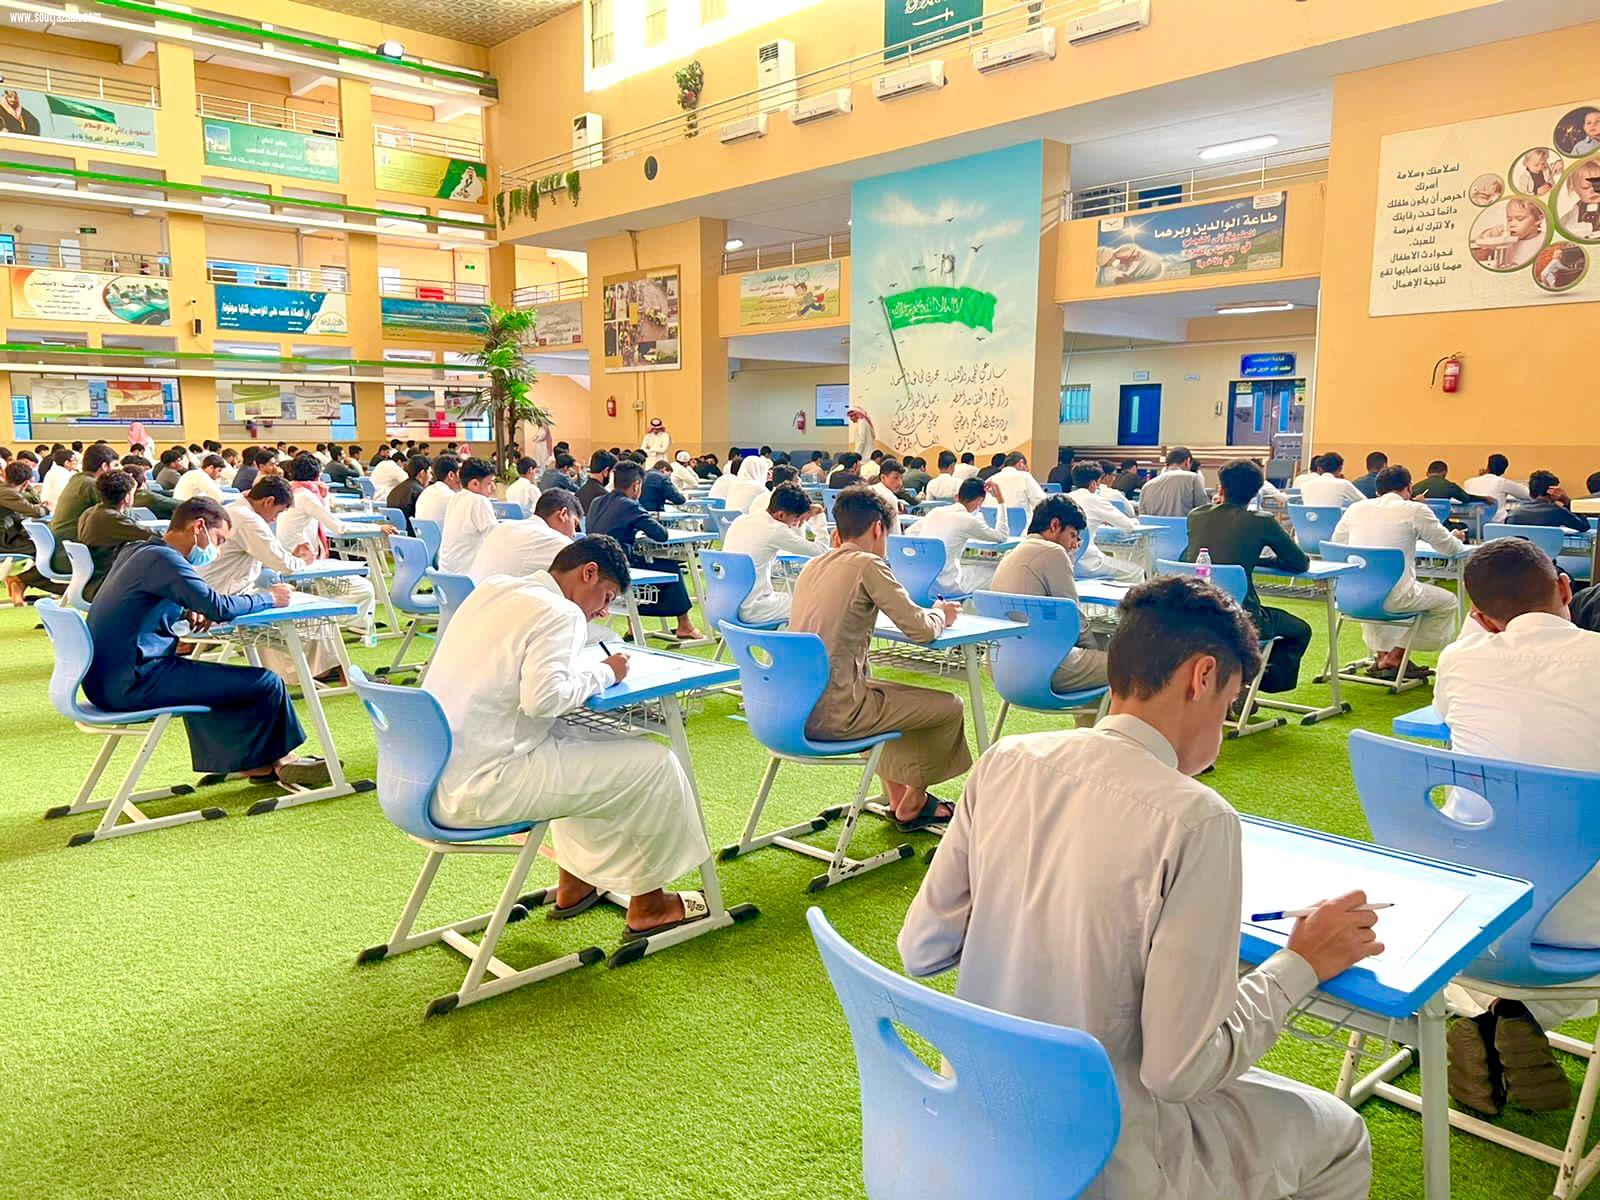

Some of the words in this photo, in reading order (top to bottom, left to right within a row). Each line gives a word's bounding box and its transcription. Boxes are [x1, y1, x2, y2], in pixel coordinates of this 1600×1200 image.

[1396, 169, 1425, 180] وسلامة
[1426, 162, 1460, 176] لسلامتك
[1386, 199, 1409, 209] طفلك
[1410, 195, 1429, 207] يكون
[1418, 208, 1436, 218] تحت
[1242, 212, 1279, 226] طاعة
[1444, 219, 1455, 230] ولا
[1192, 217, 1240, 236] الوالدين
[1393, 226, 1414, 235] فرصة
[1415, 222, 1424, 231] له
[1425, 222, 1442, 232] تترك
[1154, 226, 1191, 239] وبرهما
[1421, 248, 1453, 259] فحوادث
[1394, 264, 1421, 276] اسبابها
[1422, 262, 1441, 272] كانت
[1442, 262, 1462, 271] مهما
[1379, 268, 1393, 278] تقع
[1423, 276, 1446, 287] نتيجة
